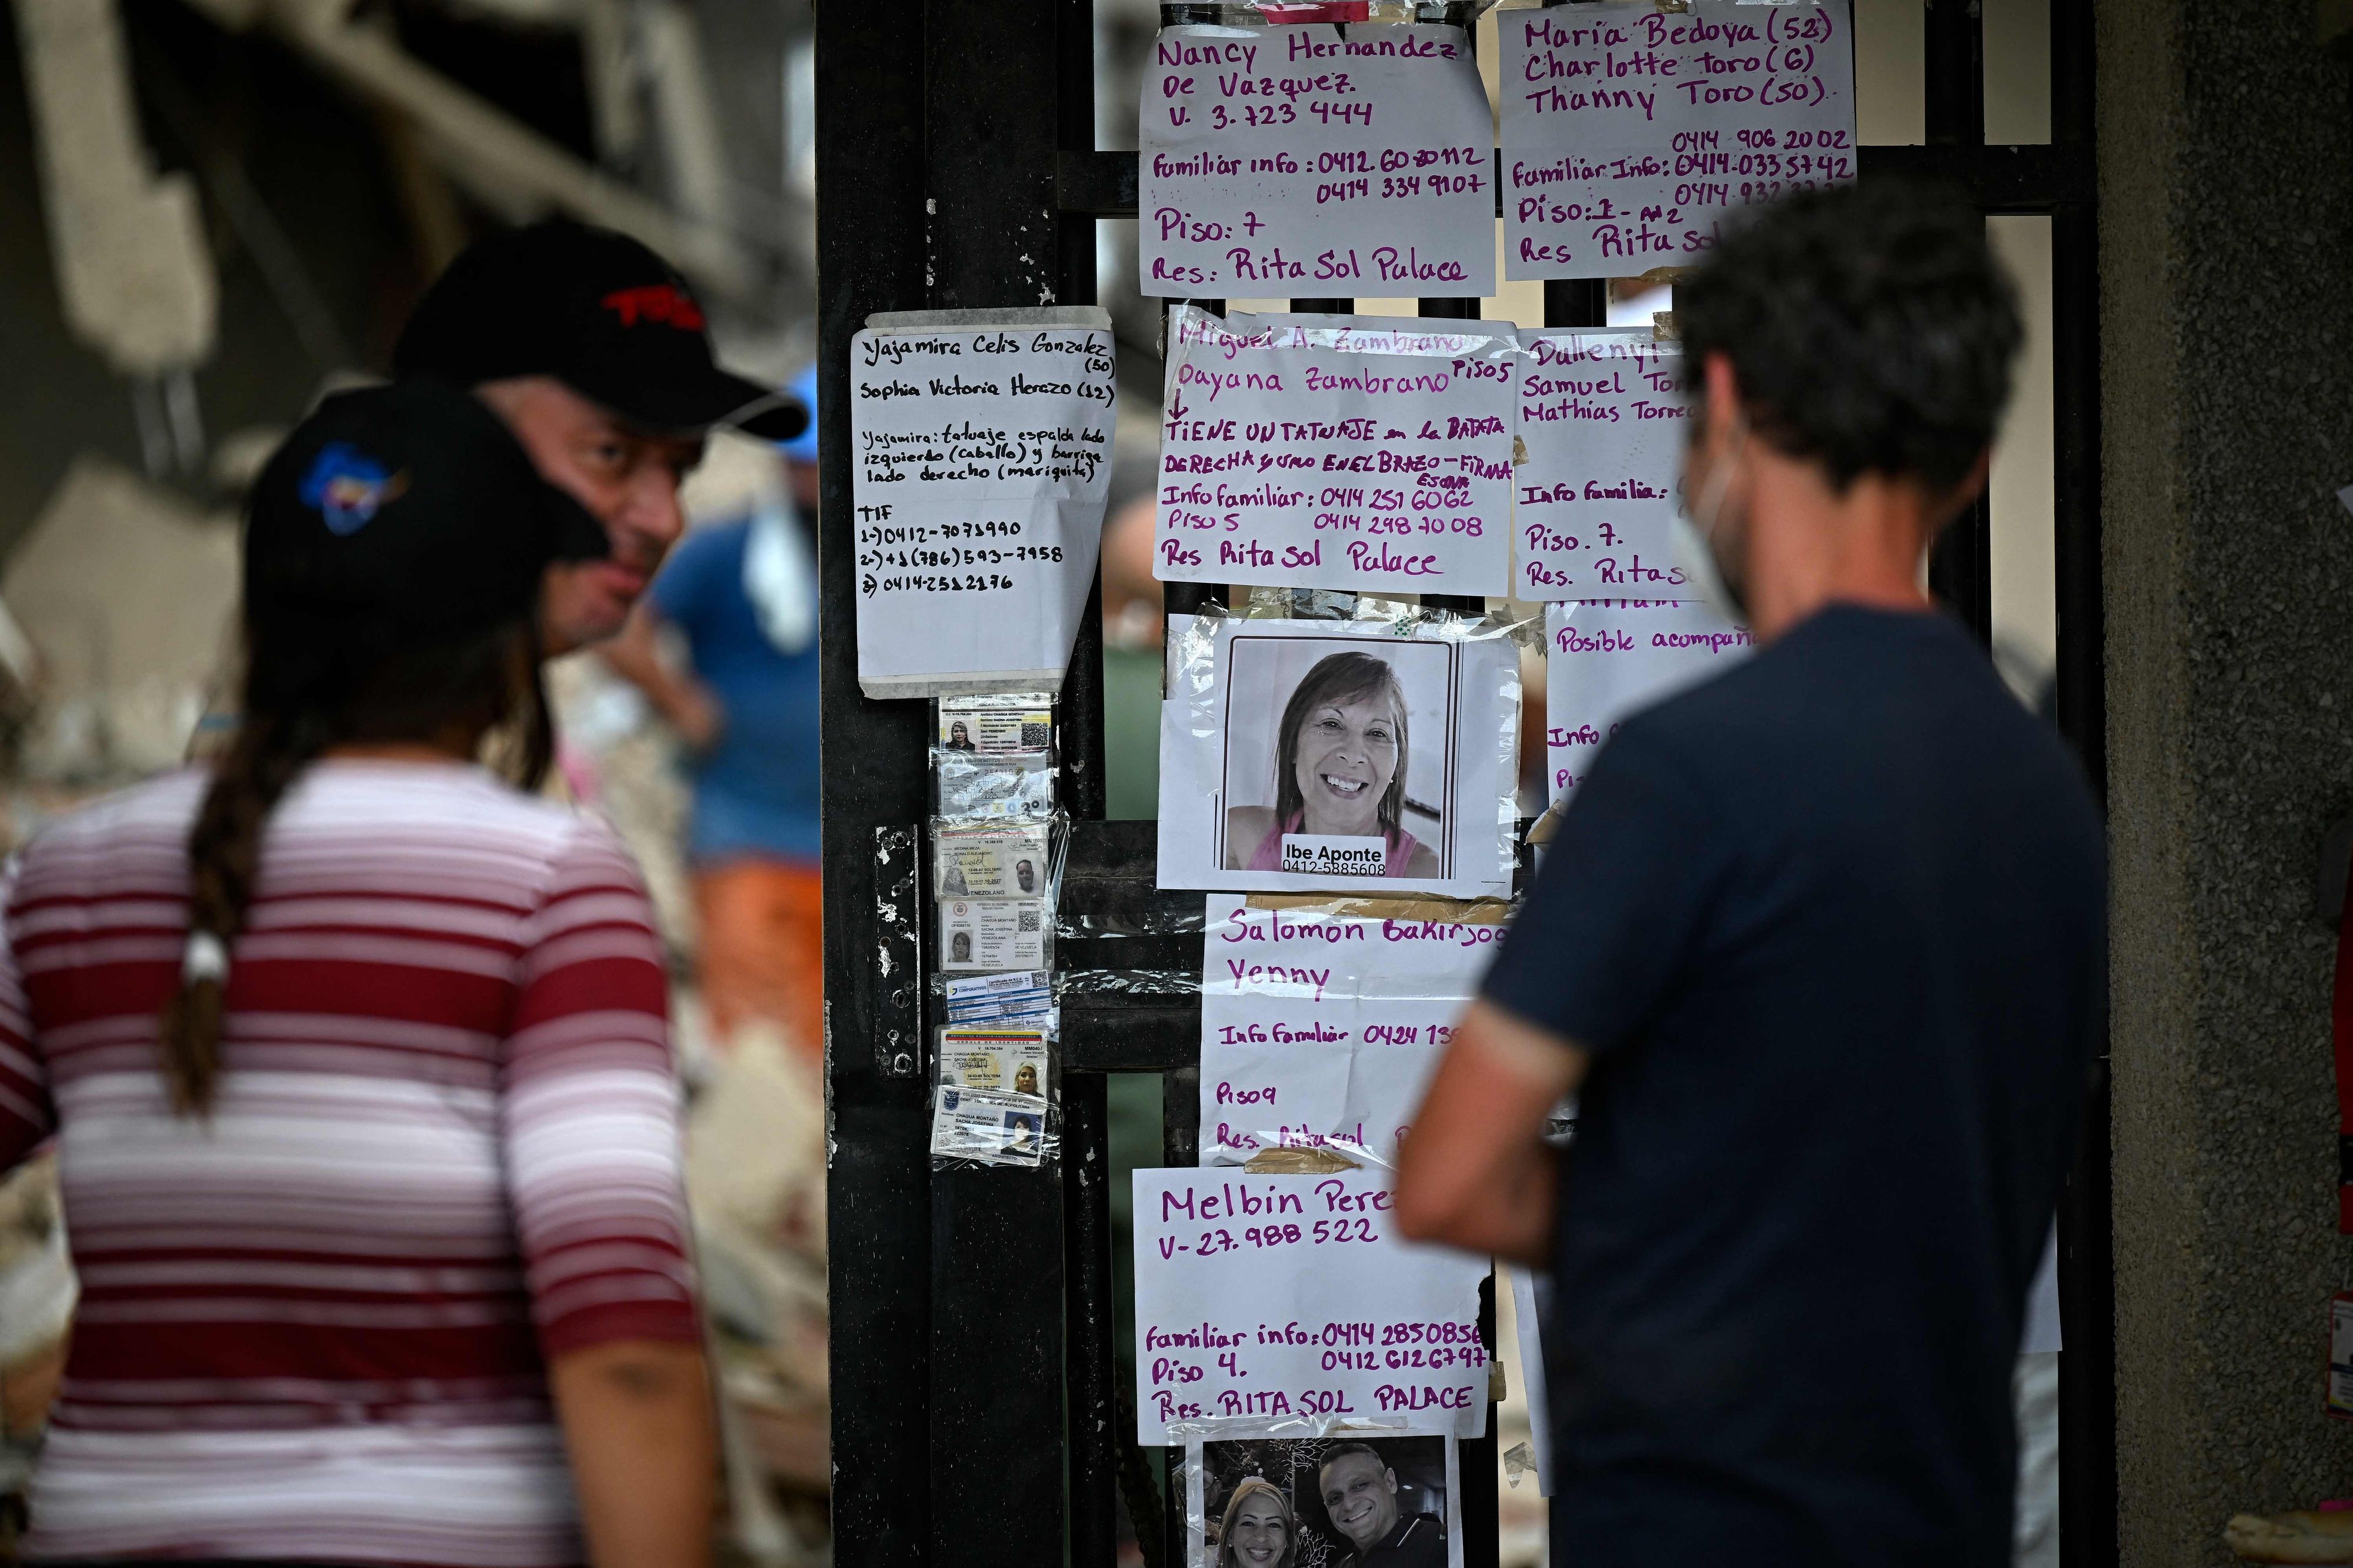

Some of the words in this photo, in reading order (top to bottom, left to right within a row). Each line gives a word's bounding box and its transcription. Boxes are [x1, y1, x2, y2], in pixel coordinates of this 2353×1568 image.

[1639, 13, 1761, 49] Bedoya
[1767, 8, 1832, 44] (52)
[1158, 40, 1257, 74] Nancy
[1288, 31, 1458, 62] Hernandez
[1525, 51, 1677, 81] Charlotte
[1765, 44, 1814, 73] (6)
[1163, 75, 1194, 98] De
[1525, 85, 1656, 121] Thanny
[1677, 79, 1755, 105] Toro
[1169, 106, 1191, 126] V.
[1309, 101, 1372, 126] 444
[1672, 129, 1719, 153] 0414
[1317, 178, 1368, 204] 0414
[1674, 183, 1729, 206] 0414
[1154, 207, 1232, 242] Piso:
[1242, 212, 1266, 237] 7
[1520, 236, 1571, 263] Res
[1592, 223, 1675, 258] Rita
[1152, 256, 1217, 284] Res:
[1227, 246, 1306, 281] Rita
[1314, 249, 1361, 281] Sol
[1372, 246, 1469, 281] Palace
[862, 338, 962, 366] Yajamira
[973, 332, 1020, 354] Celis
[1031, 332, 1108, 356] Gonzalez
[1179, 322, 1278, 361] Miguel
[1292, 326, 1314, 348] A.
[1334, 326, 1464, 352] Zambrano
[1085, 356, 1115, 380] (50)
[861, 379, 921, 400] Sophia
[929, 374, 1000, 396] Victoria
[1011, 373, 1071, 395] Herazo
[1077, 382, 1115, 408] (12)
[1179, 364, 1284, 402] Dayana
[1305, 367, 1449, 393] Zambrano
[1522, 372, 1626, 397] Samuel
[1522, 398, 1619, 422] Mathias
[942, 421, 1006, 446] tatuaje
[1018, 427, 1074, 447] espalda
[1081, 428, 1104, 443] lado
[865, 449, 944, 470] izquierdo
[1052, 444, 1104, 466] barriga
[1164, 449, 1255, 473] DERECHA
[868, 469, 905, 483] lado
[920, 462, 989, 481] derecho
[998, 458, 1094, 483] (mariquita)
[1162, 486, 1212, 506] Info
[1320, 488, 1363, 508] 0414
[1369, 489, 1404, 511] 251
[1411, 490, 1474, 511] 6062
[1519, 483, 1575, 505] Info
[1169, 509, 1216, 529] Piso
[1224, 513, 1240, 532] 5
[1314, 511, 1360, 531] 0414
[1599, 522, 1623, 547] 7.
[1161, 539, 1202, 566] Res
[1220, 539, 1274, 567] Rita
[1347, 541, 1444, 575] Palace
[1527, 561, 1573, 586] Res.
[1556, 626, 1635, 653] Posible
[1548, 724, 1599, 747] Info
[1286, 844, 1312, 859] Ibe
[1318, 846, 1381, 864] Aponte
[1282, 859, 1385, 876] 0412-5885608
[1221, 909, 1364, 943] Salomon
[1227, 959, 1330, 1002] Yenny
[1218, 1023, 1269, 1045] Info
[1363, 1025, 1420, 1046] 0424
[1162, 1183, 1303, 1222] Melbin
[1314, 1179, 1397, 1212] Pere
[1312, 1218, 1378, 1245] 522
[1321, 1322, 1374, 1347] 0414
[1152, 1356, 1204, 1385] Piso
[1218, 1353, 1247, 1378] 4.
[1321, 1350, 1379, 1371] 0412
[1151, 1389, 1213, 1423] Res.
[1218, 1389, 1291, 1417] RITA
[1297, 1390, 1354, 1417] SOL
[1374, 1385, 1473, 1411] PALACE
